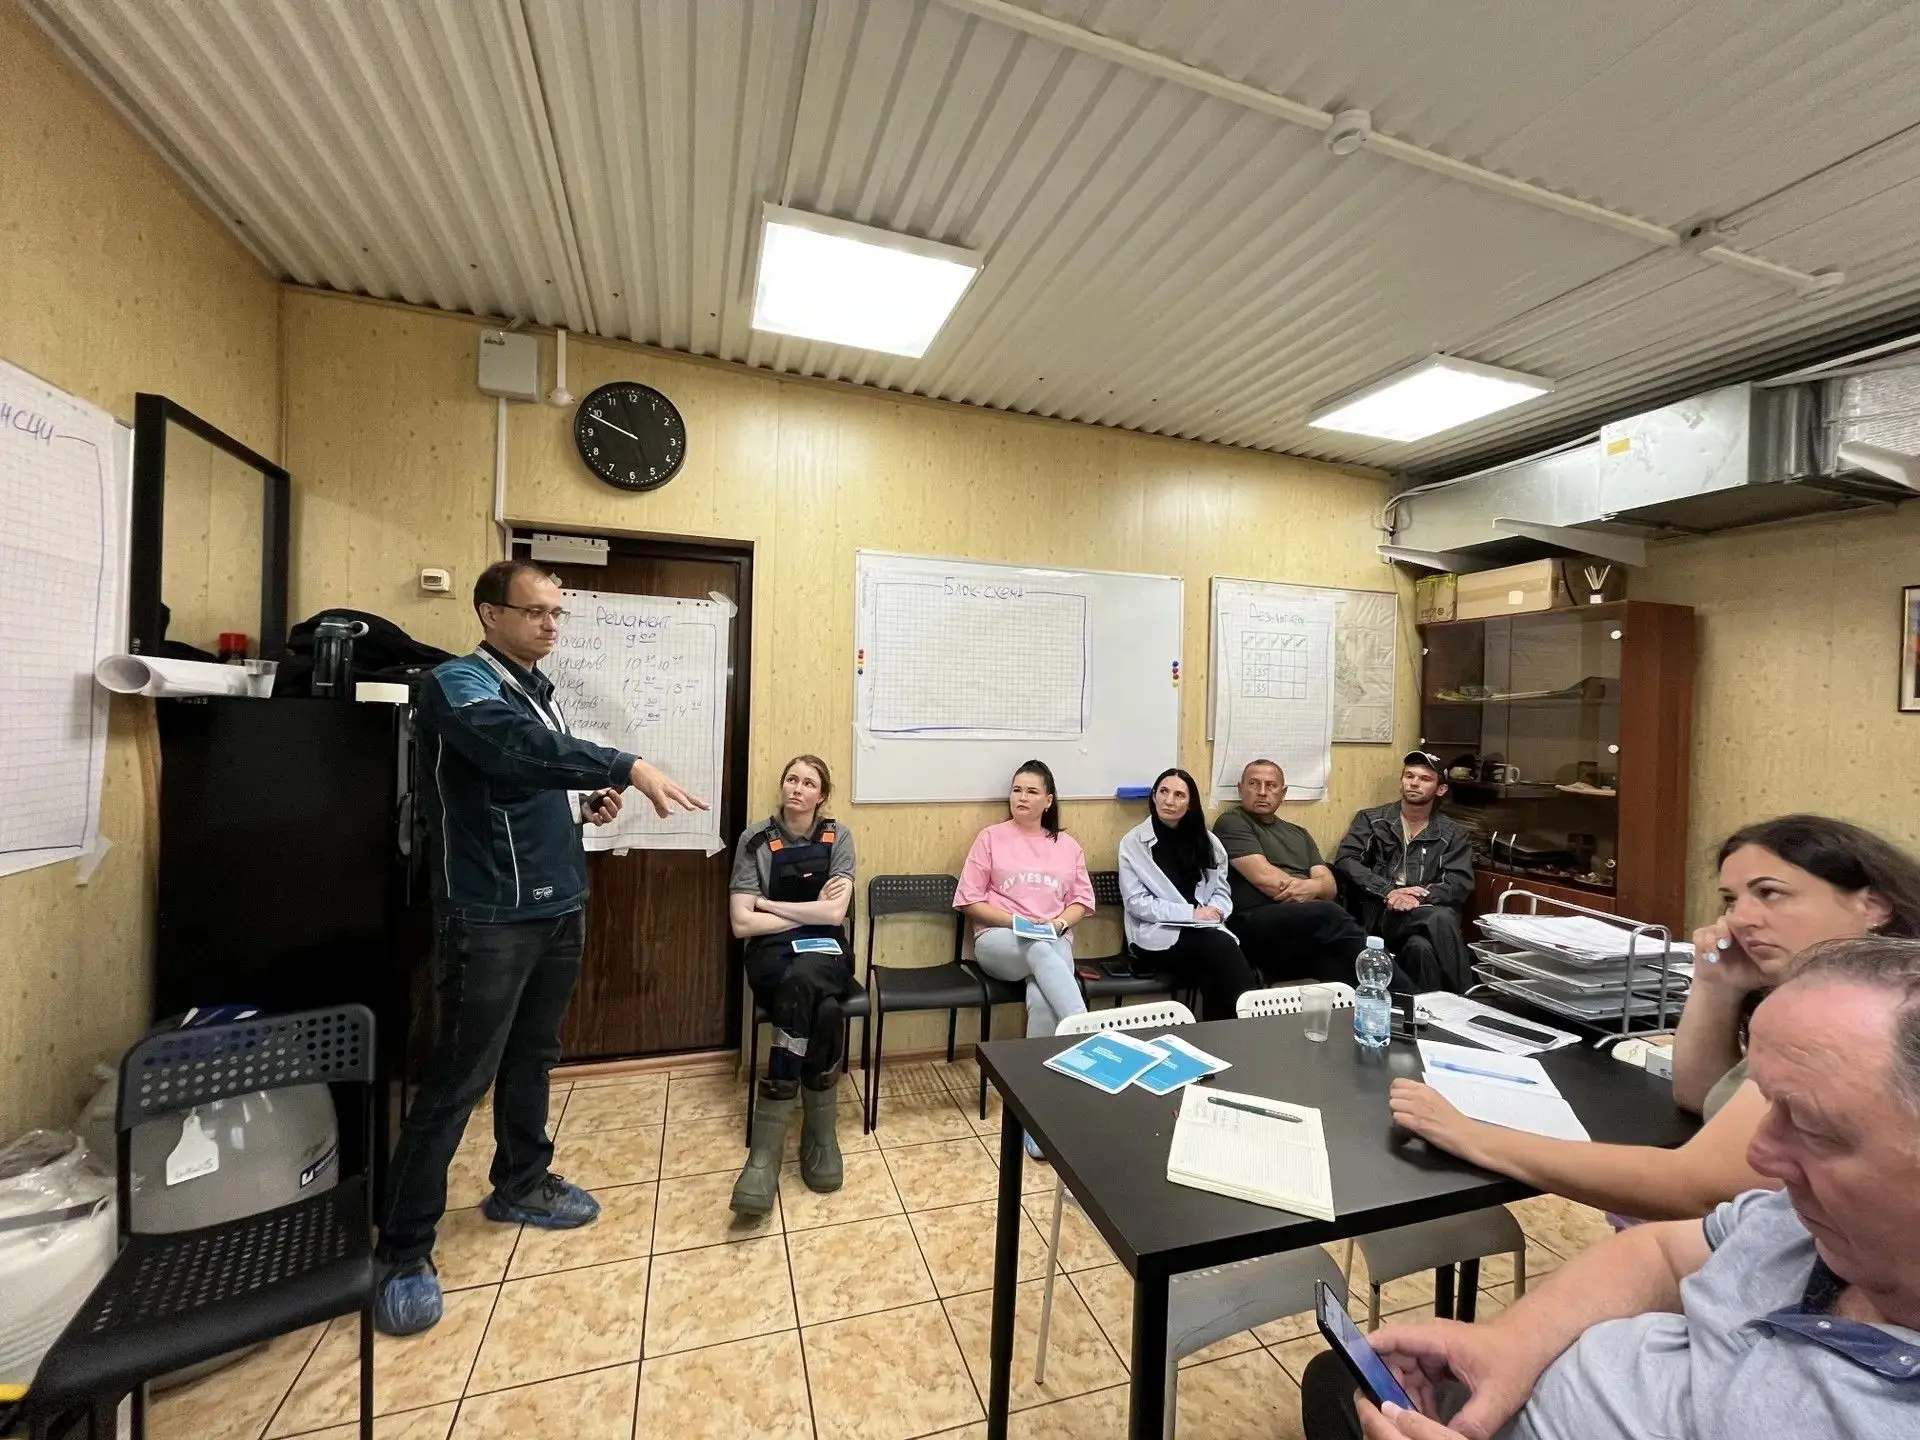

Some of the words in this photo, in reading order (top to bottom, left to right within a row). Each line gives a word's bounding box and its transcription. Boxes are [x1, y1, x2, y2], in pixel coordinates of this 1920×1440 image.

[608, 398, 616, 406] 11
[629, 395, 637, 403] 12
[651, 403, 656, 411] 1
[593, 410, 602, 418] 10
[664, 418, 669, 426] 2
[588, 428, 594, 437] 9
[670, 438, 676, 447] 3
[593, 447, 599, 456] 8
[665, 455, 671, 463] 4
[608, 463, 615, 472] 7
[650, 467, 656, 476] 5
[629, 472, 636, 480] 6
[1019, 872, 1042, 884] YES
